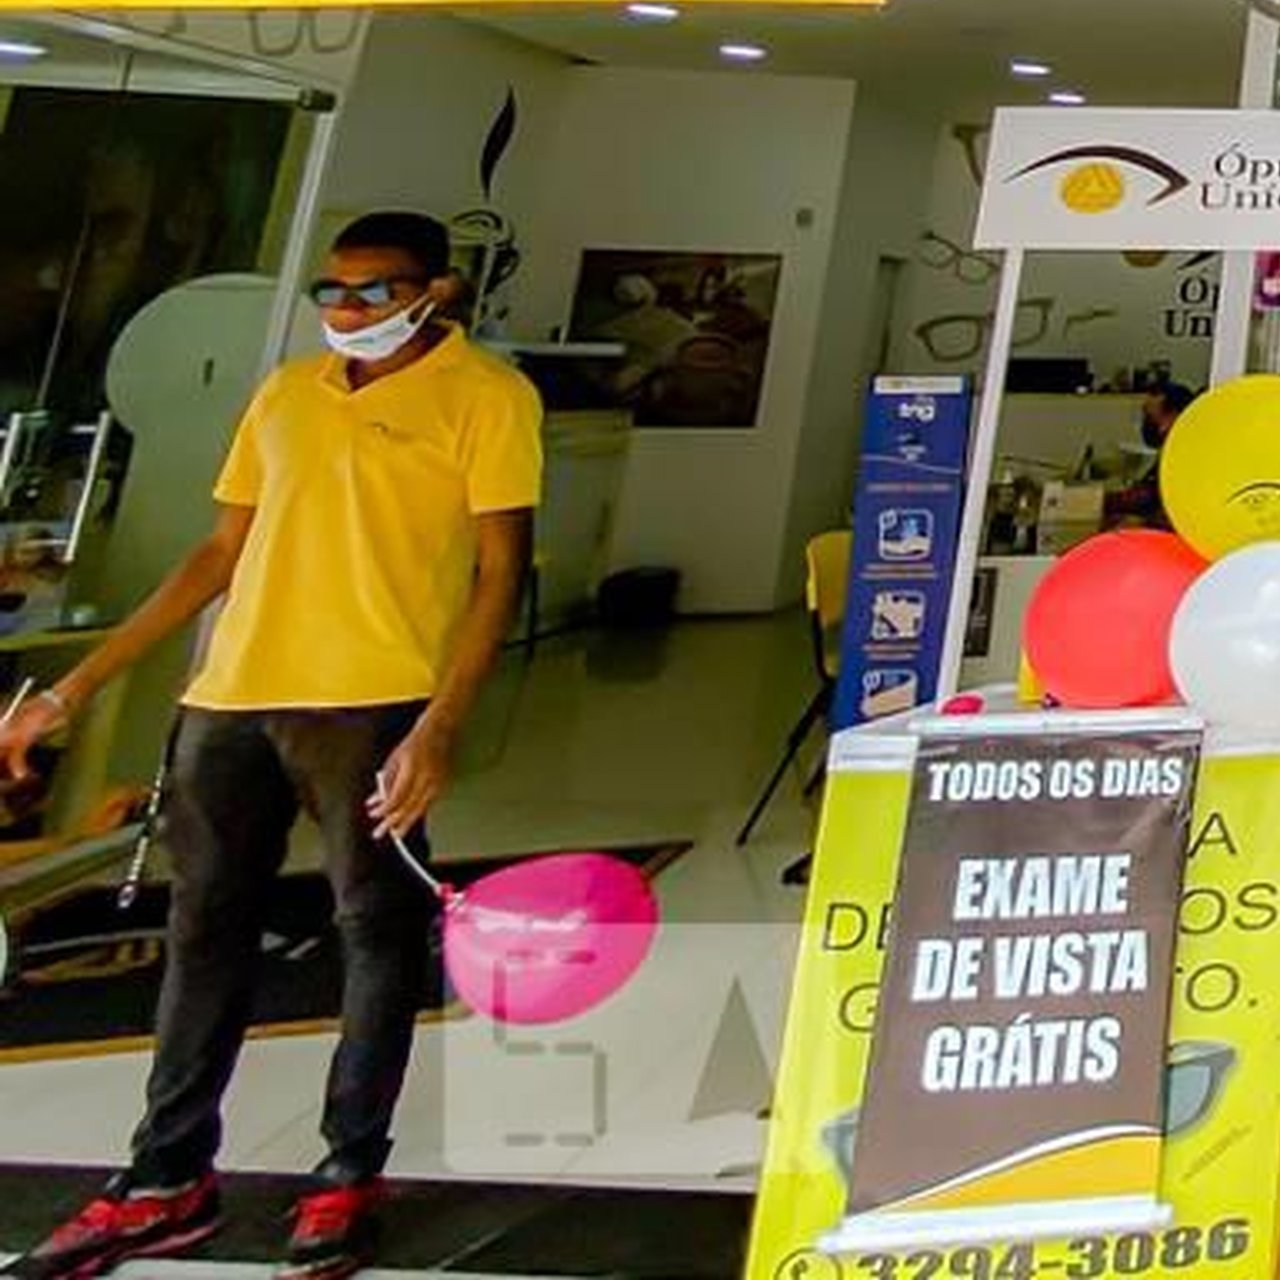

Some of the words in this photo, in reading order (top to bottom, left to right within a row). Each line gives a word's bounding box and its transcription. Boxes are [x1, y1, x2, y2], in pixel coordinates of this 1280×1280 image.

[927, 760, 1041, 803] TODOS
[1048, 758, 1096, 799] OS
[1101, 756, 1182, 798] DIAS
[952, 852, 1132, 922] EXAME
[910, 937, 984, 1003] DE
[993, 929, 1149, 1000] VISTA
[921, 1011, 1122, 1093] GRÁTIS
